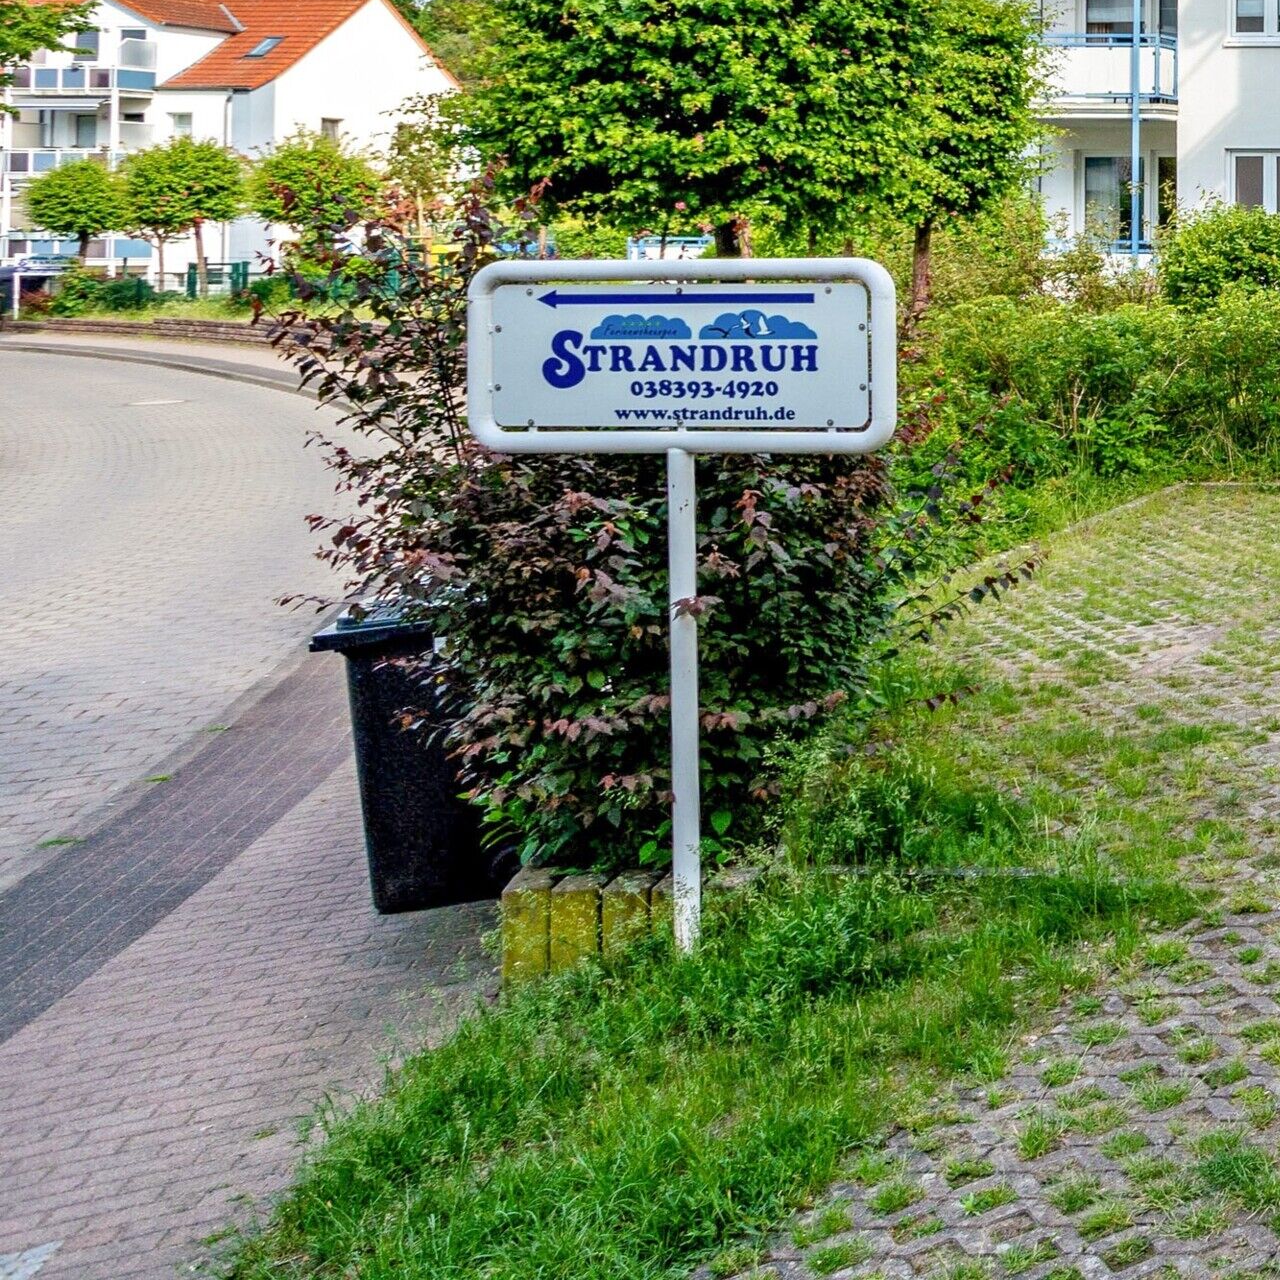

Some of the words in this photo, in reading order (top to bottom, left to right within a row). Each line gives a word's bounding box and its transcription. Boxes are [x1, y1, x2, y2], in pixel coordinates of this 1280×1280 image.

[542, 329, 819, 389] STRANDRUH
[630, 379, 779, 399] 038393-4920
[614, 406, 796, 421] www.strandruh.de
